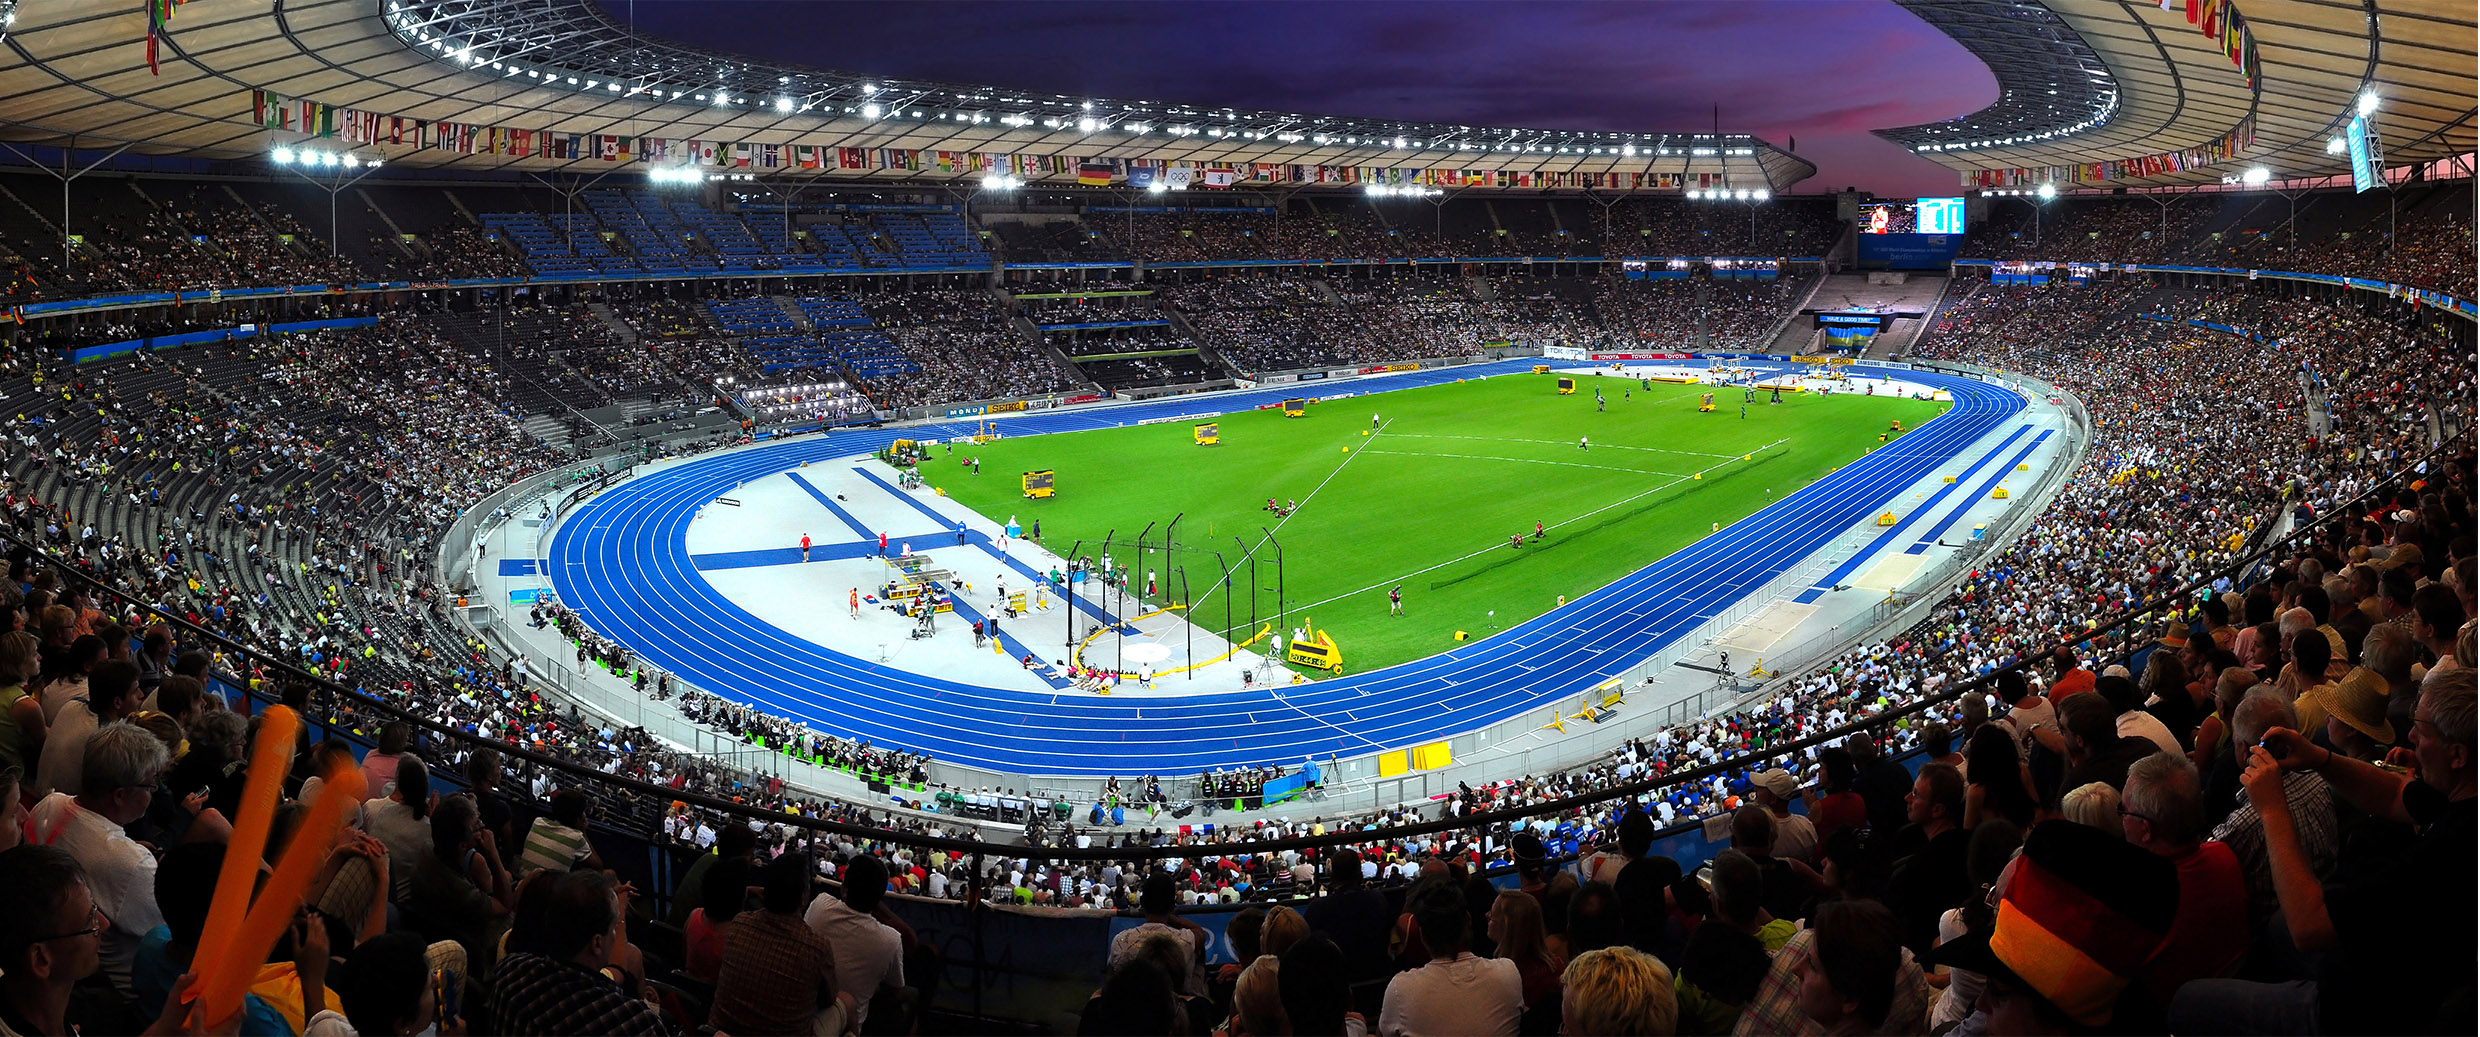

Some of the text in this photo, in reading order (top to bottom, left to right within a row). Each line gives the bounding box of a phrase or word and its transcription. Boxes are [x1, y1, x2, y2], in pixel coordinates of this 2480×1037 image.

[1391, 364, 1415, 372] SEIKO
[950, 406, 985, 416] MONDO
[992, 403, 1021, 413] SEIKO
[616, 468, 631, 479] adidas
[587, 481, 602, 493] adidas
